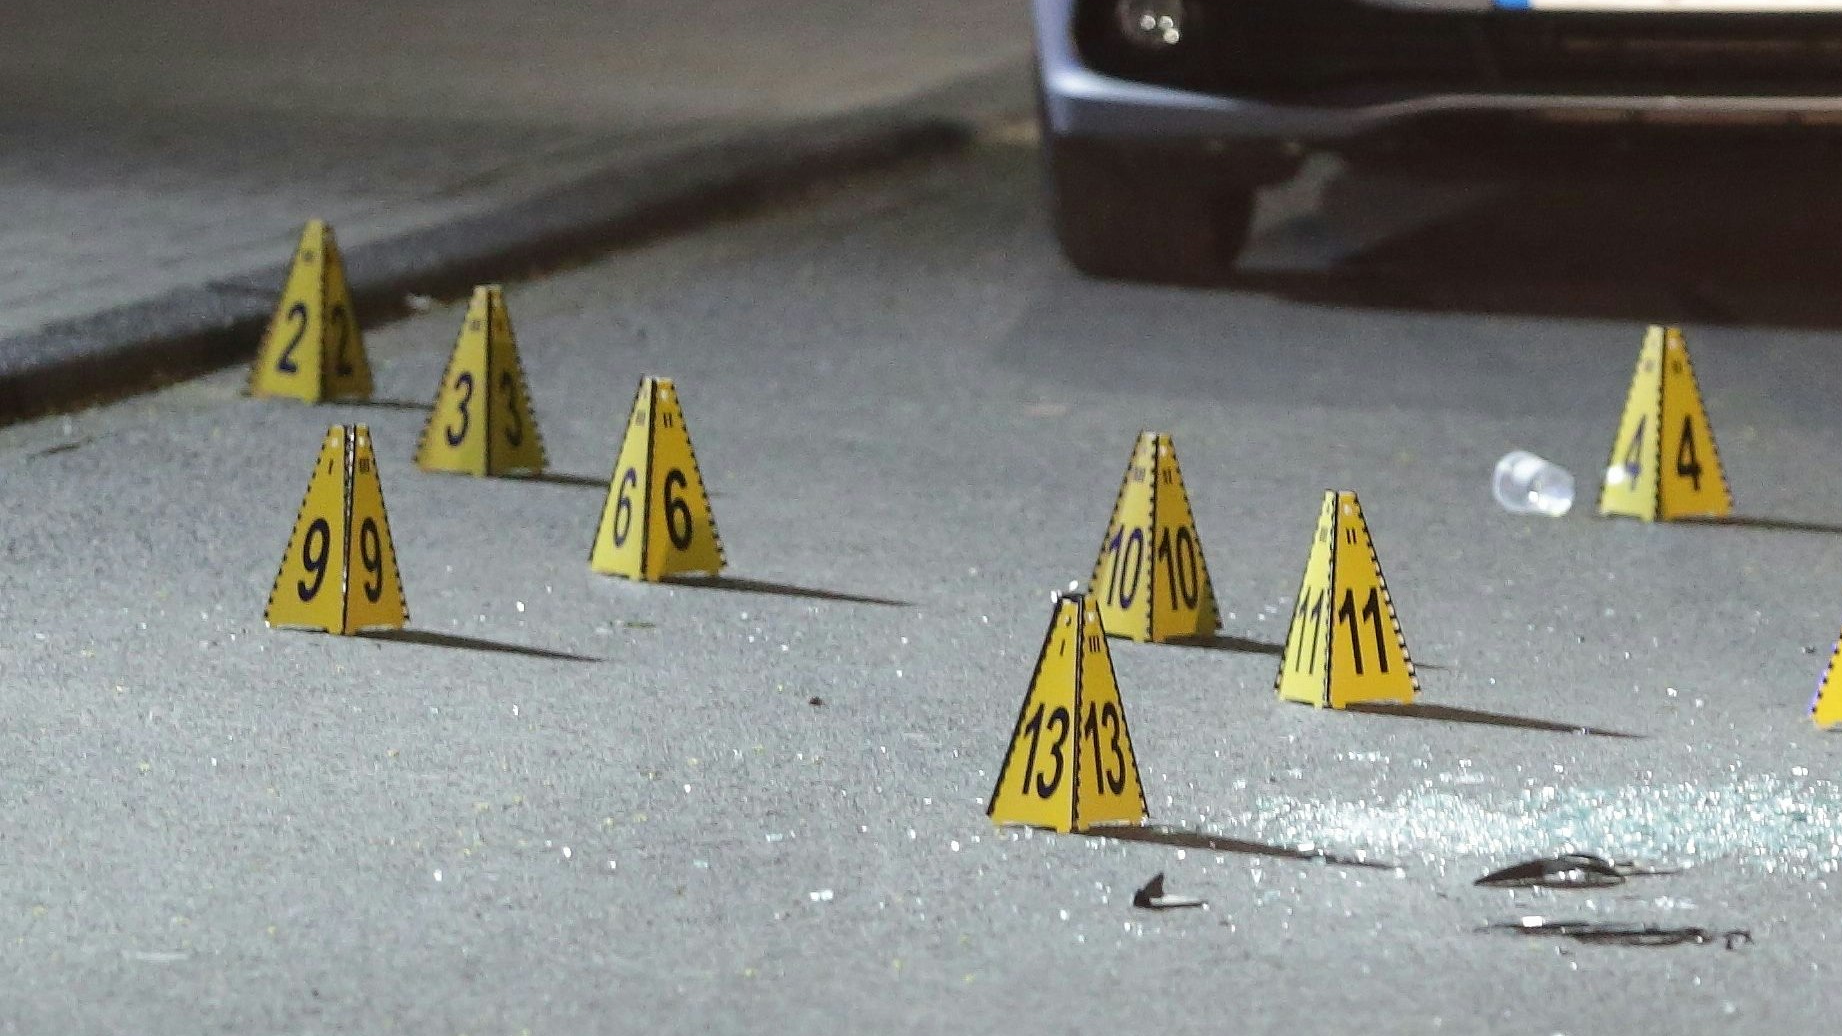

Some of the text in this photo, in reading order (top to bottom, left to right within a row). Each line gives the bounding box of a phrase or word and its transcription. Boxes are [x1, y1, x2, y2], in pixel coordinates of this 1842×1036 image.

[278, 303, 307, 374] 2
[331, 306, 353, 376] 2
[445, 371, 472, 447] 3
[503, 372, 523, 447] 3
[1625, 414, 1646, 490] 4
[1677, 414, 1701, 491] 4
[612, 467, 637, 548] 6
[663, 468, 693, 551] 6
[297, 518, 330, 602] 9
[360, 516, 382, 603] 9
[1108, 528, 1143, 609] 10
[1158, 527, 1198, 611] 10
[1295, 586, 1323, 676] 11
[1339, 587, 1389, 675] 11
[1022, 703, 1069, 799] 13
[1084, 702, 1126, 796] 13
